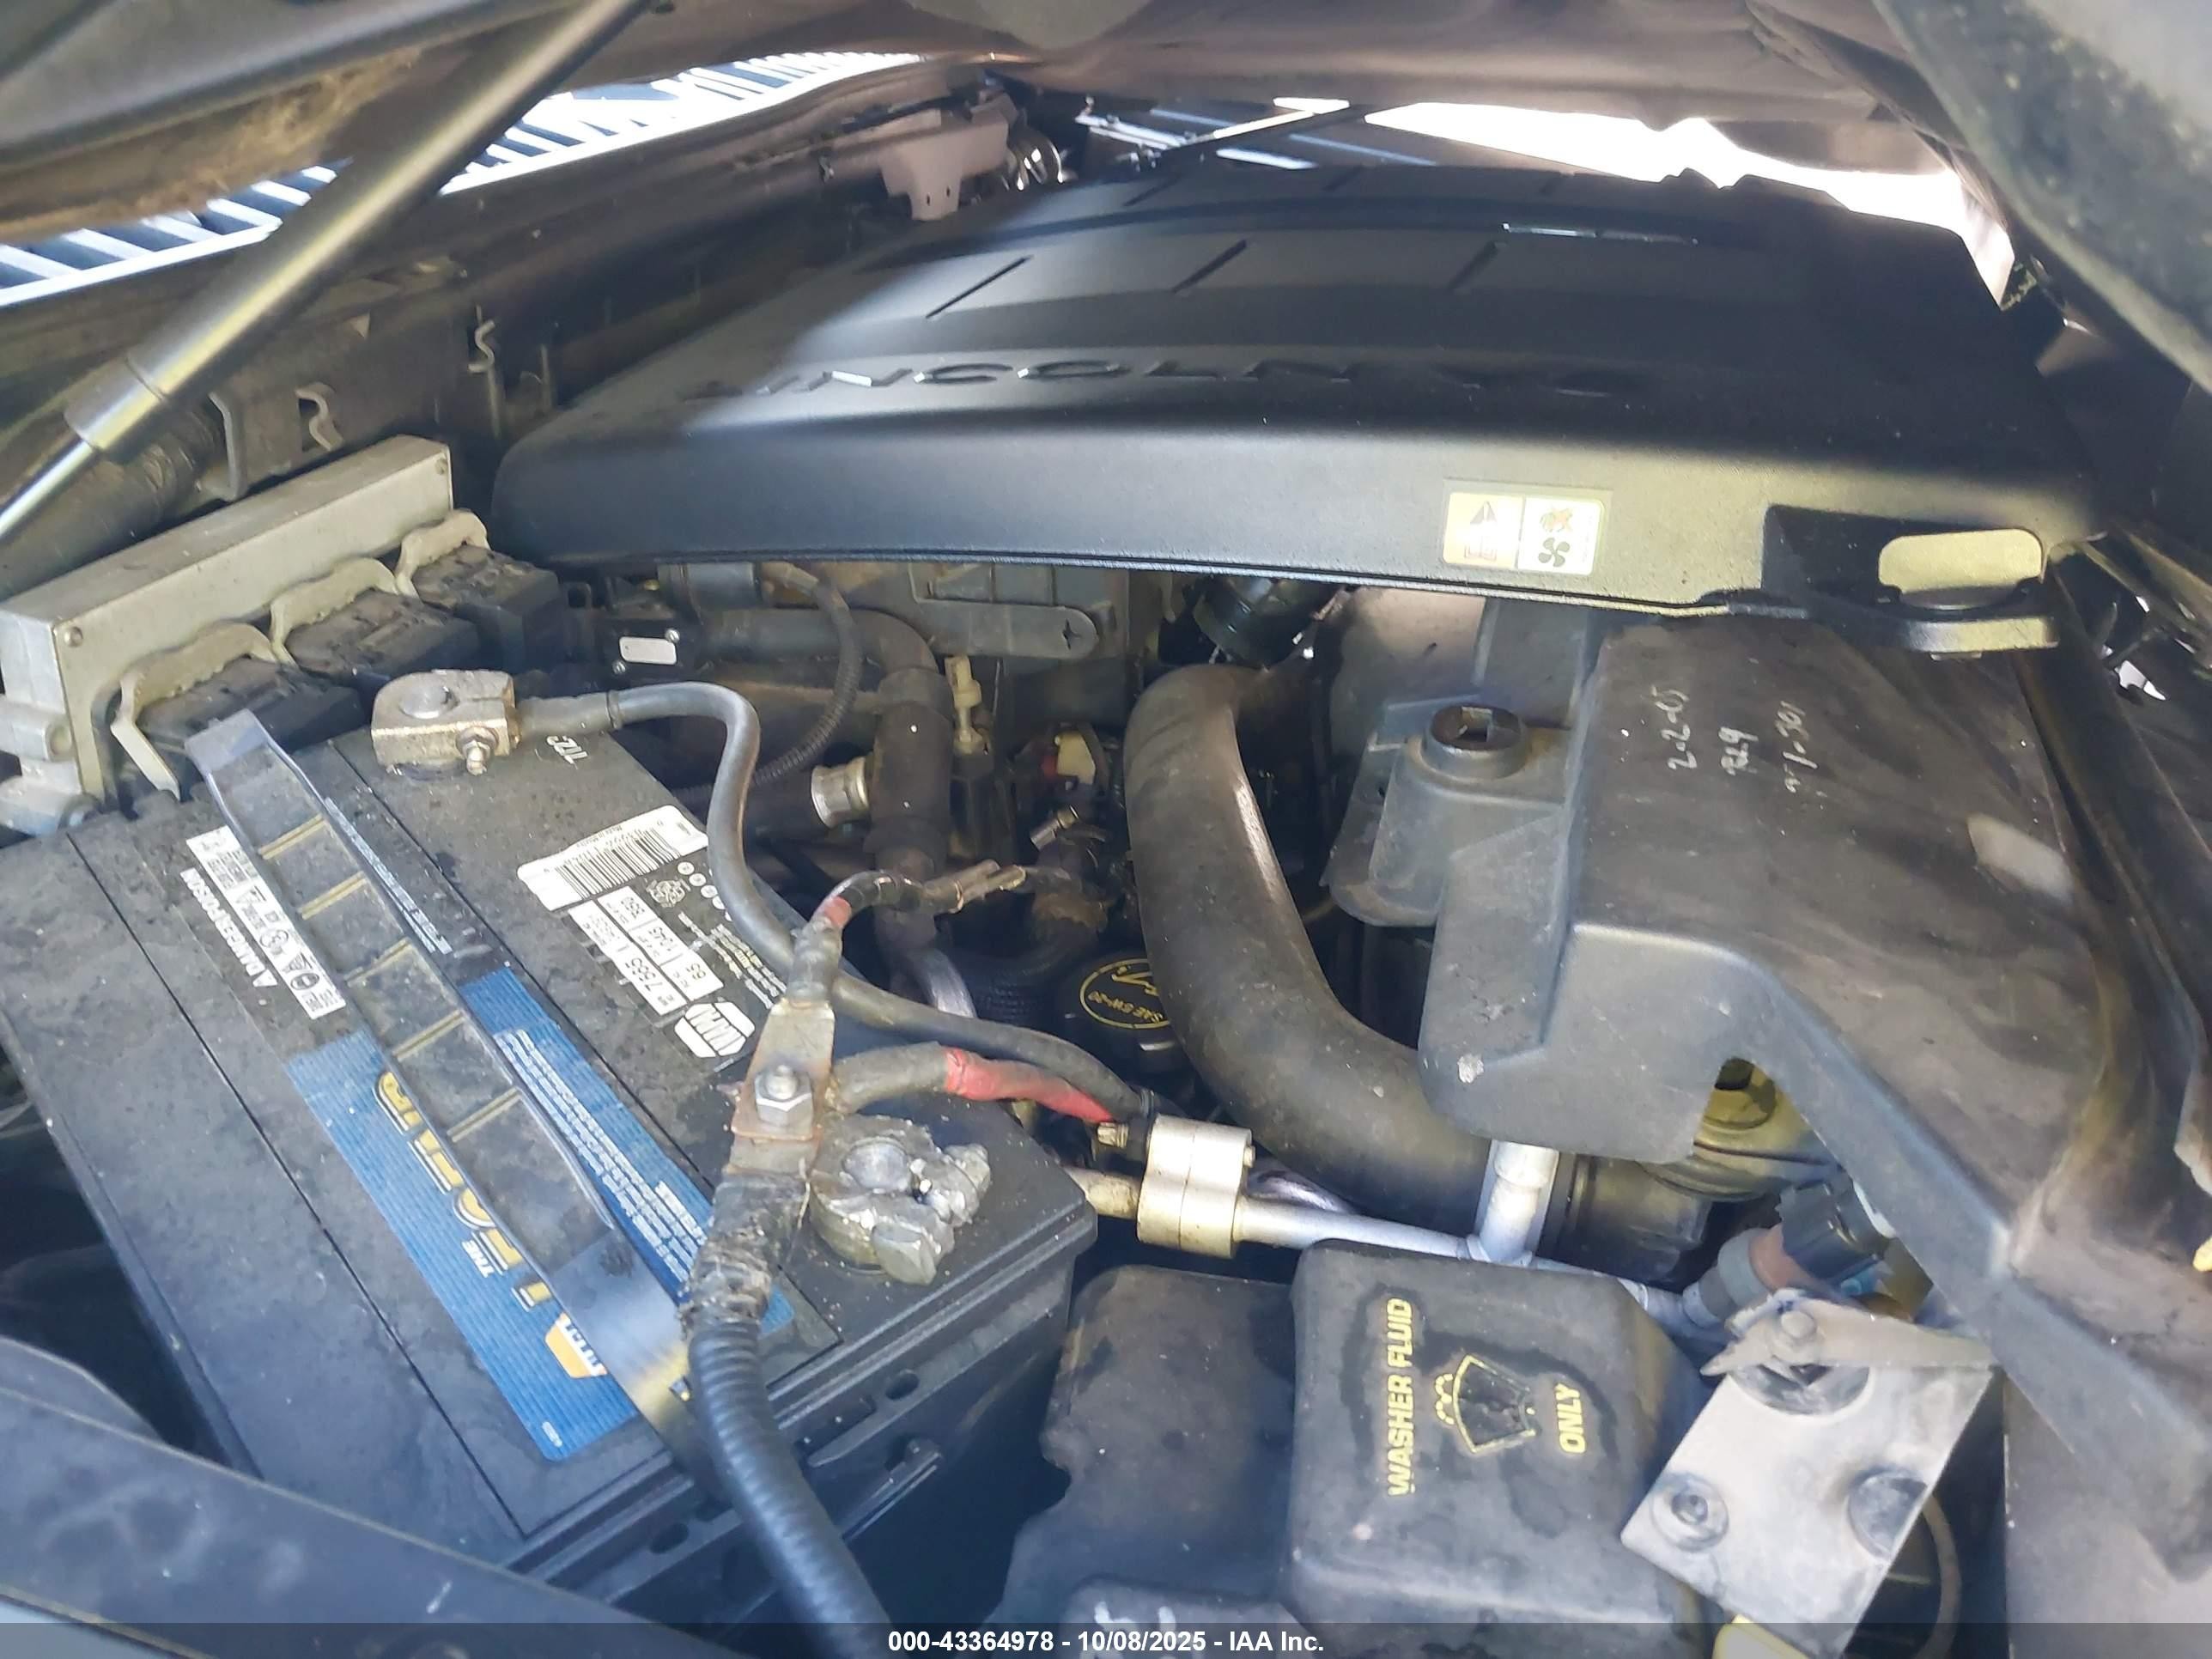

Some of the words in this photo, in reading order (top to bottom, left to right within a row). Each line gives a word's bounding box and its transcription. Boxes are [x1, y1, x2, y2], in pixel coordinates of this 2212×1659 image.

[683, 359, 1379, 397] LINCOLN
[461, 1241, 497, 1277] THE
[1387, 1297, 1414, 1368] FLUID
[1388, 1375, 1416, 1497] WASHER
[1554, 1383, 1587, 1454] ONLY
